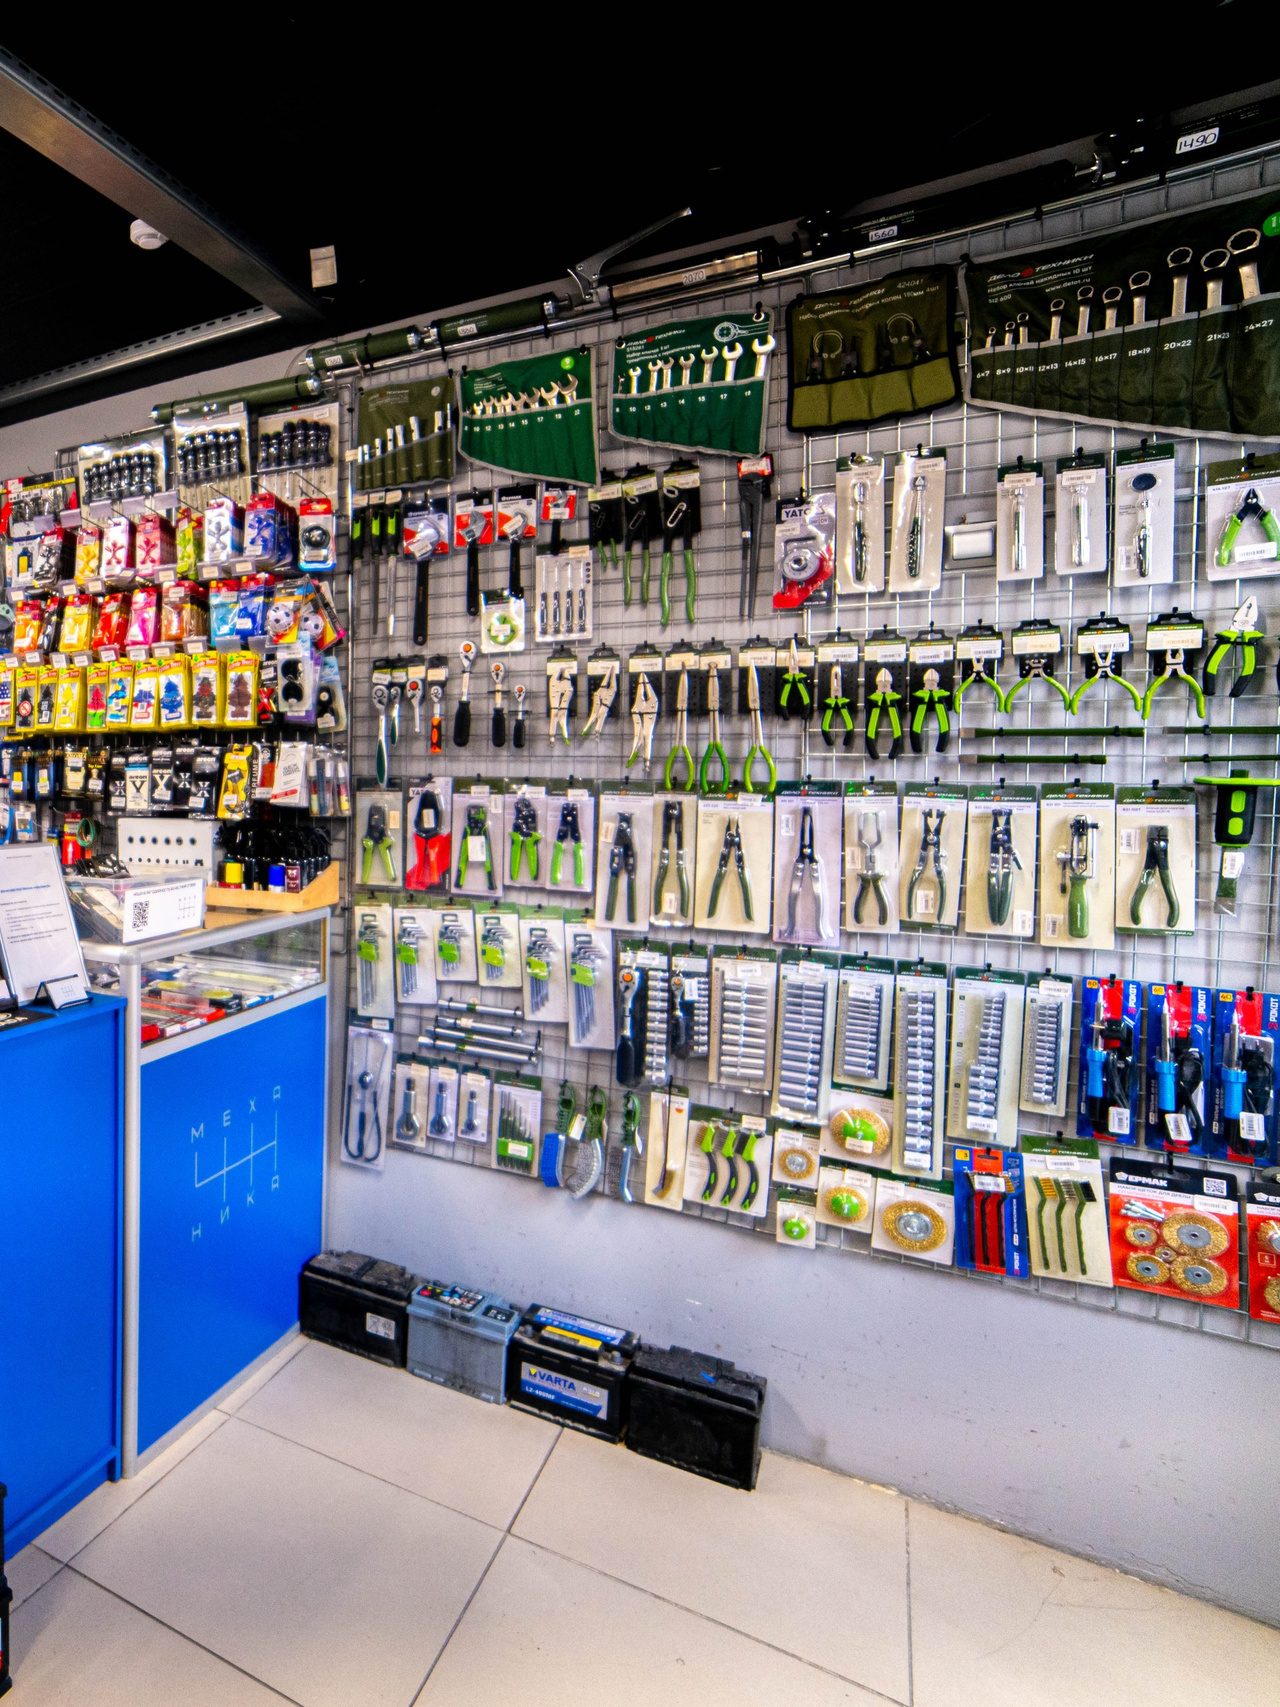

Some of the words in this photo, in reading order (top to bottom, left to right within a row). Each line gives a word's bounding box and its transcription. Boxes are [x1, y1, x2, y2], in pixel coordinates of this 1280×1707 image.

[1179, 133, 1216, 151] 1490
[870, 229, 895, 241] 1560
[683, 270, 705, 284] 2070
[1128, 1175, 1168, 1187] ЕРМАК
[539, 1371, 576, 1391] VARTA
